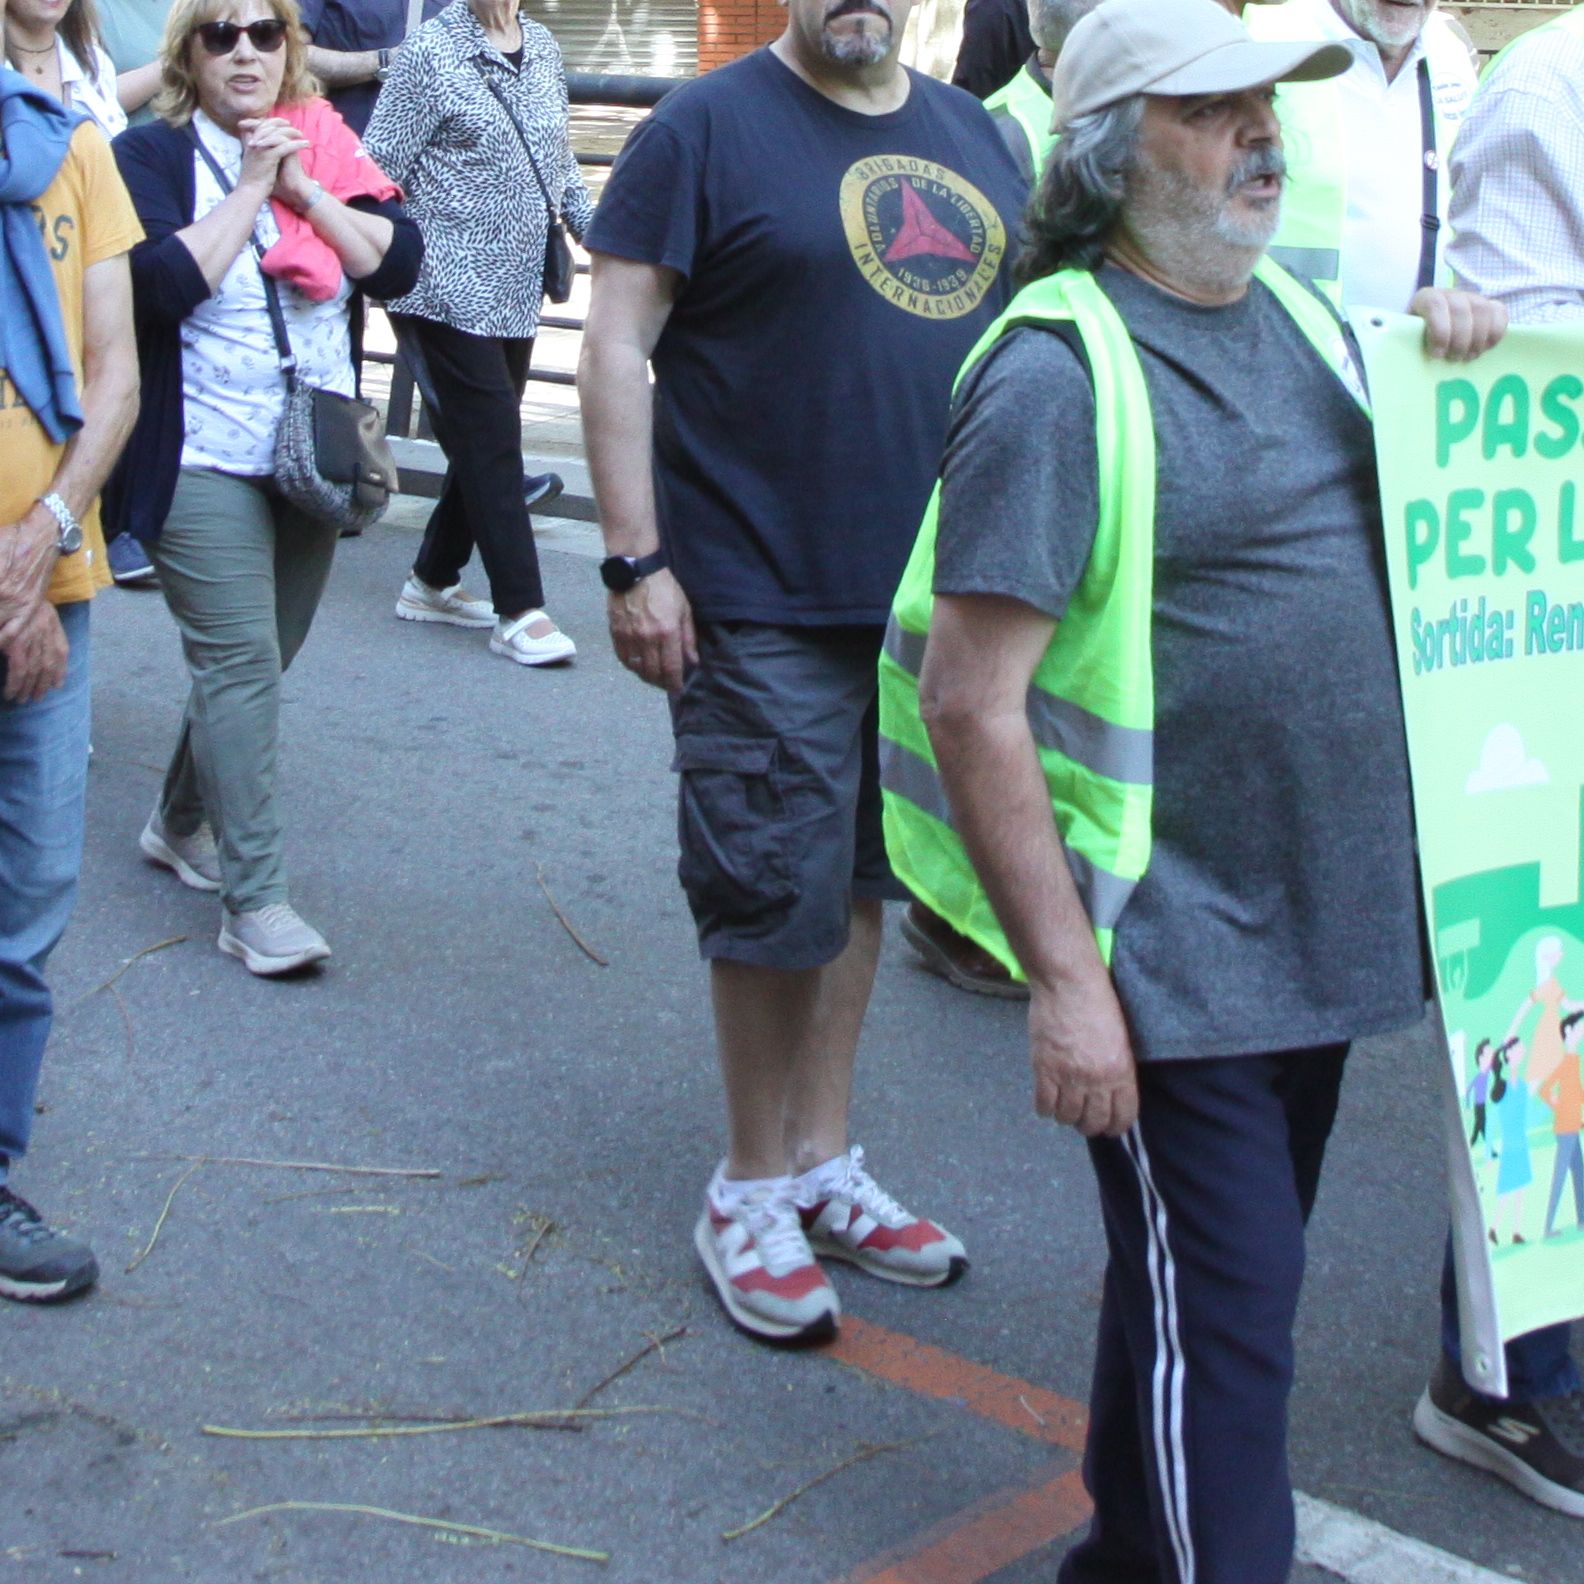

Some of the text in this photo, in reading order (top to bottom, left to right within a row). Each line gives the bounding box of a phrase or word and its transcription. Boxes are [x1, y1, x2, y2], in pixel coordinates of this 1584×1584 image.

[854, 158, 946, 181] BRIGADAS
[911, 176, 929, 191] DE
[932, 183, 948, 199] LA
[949, 191, 984, 255] LIBERTAD
[854, 241, 1001, 317] INTERNACIONALES
[897, 266, 967, 293] 1936-1939
[1403, 486, 1538, 592] PER
